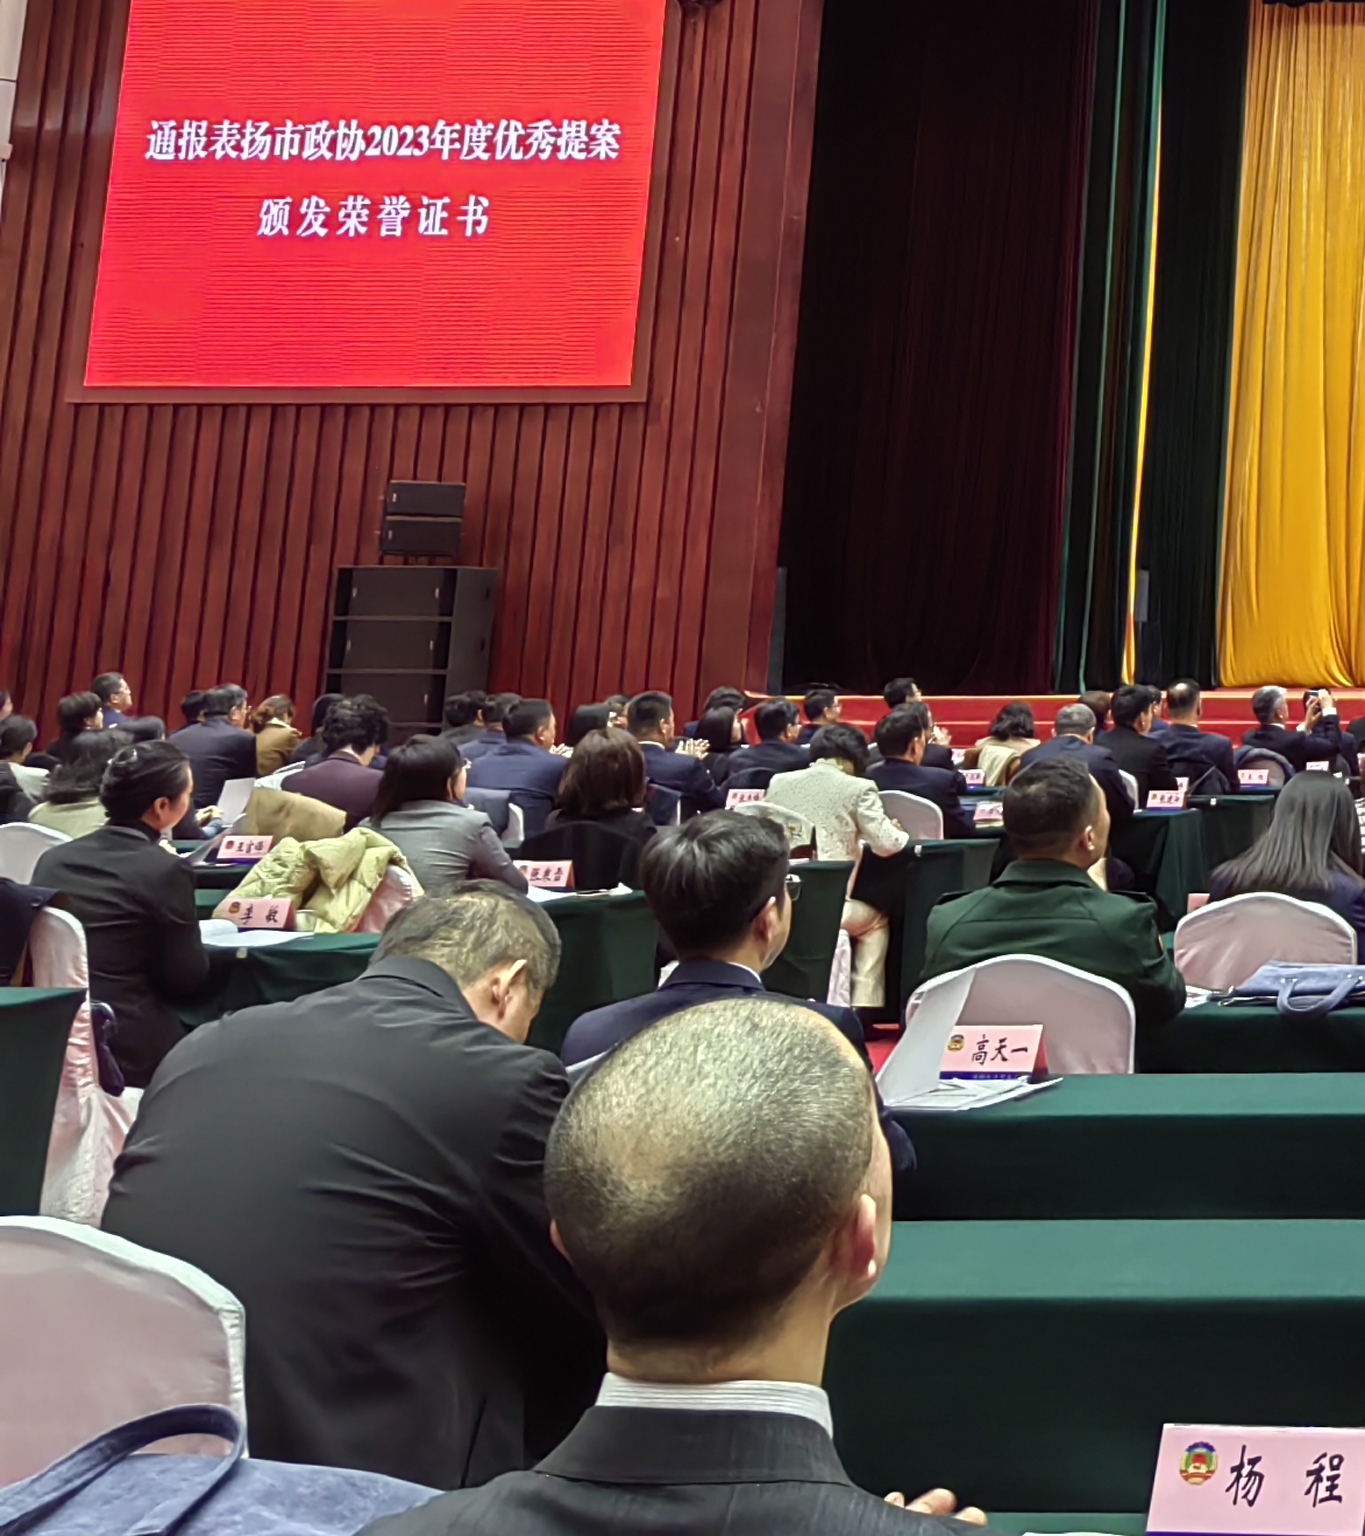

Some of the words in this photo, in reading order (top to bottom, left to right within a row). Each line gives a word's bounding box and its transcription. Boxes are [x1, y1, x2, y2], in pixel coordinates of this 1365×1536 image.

[144, 118, 622, 162] 通报表扬市政协2023年度优秀提案
[256, 194, 491, 238] 颁发荣誉证书
[971, 1033, 1029, 1066] 高天一
[1224, 1444, 1345, 1508] 杨程
